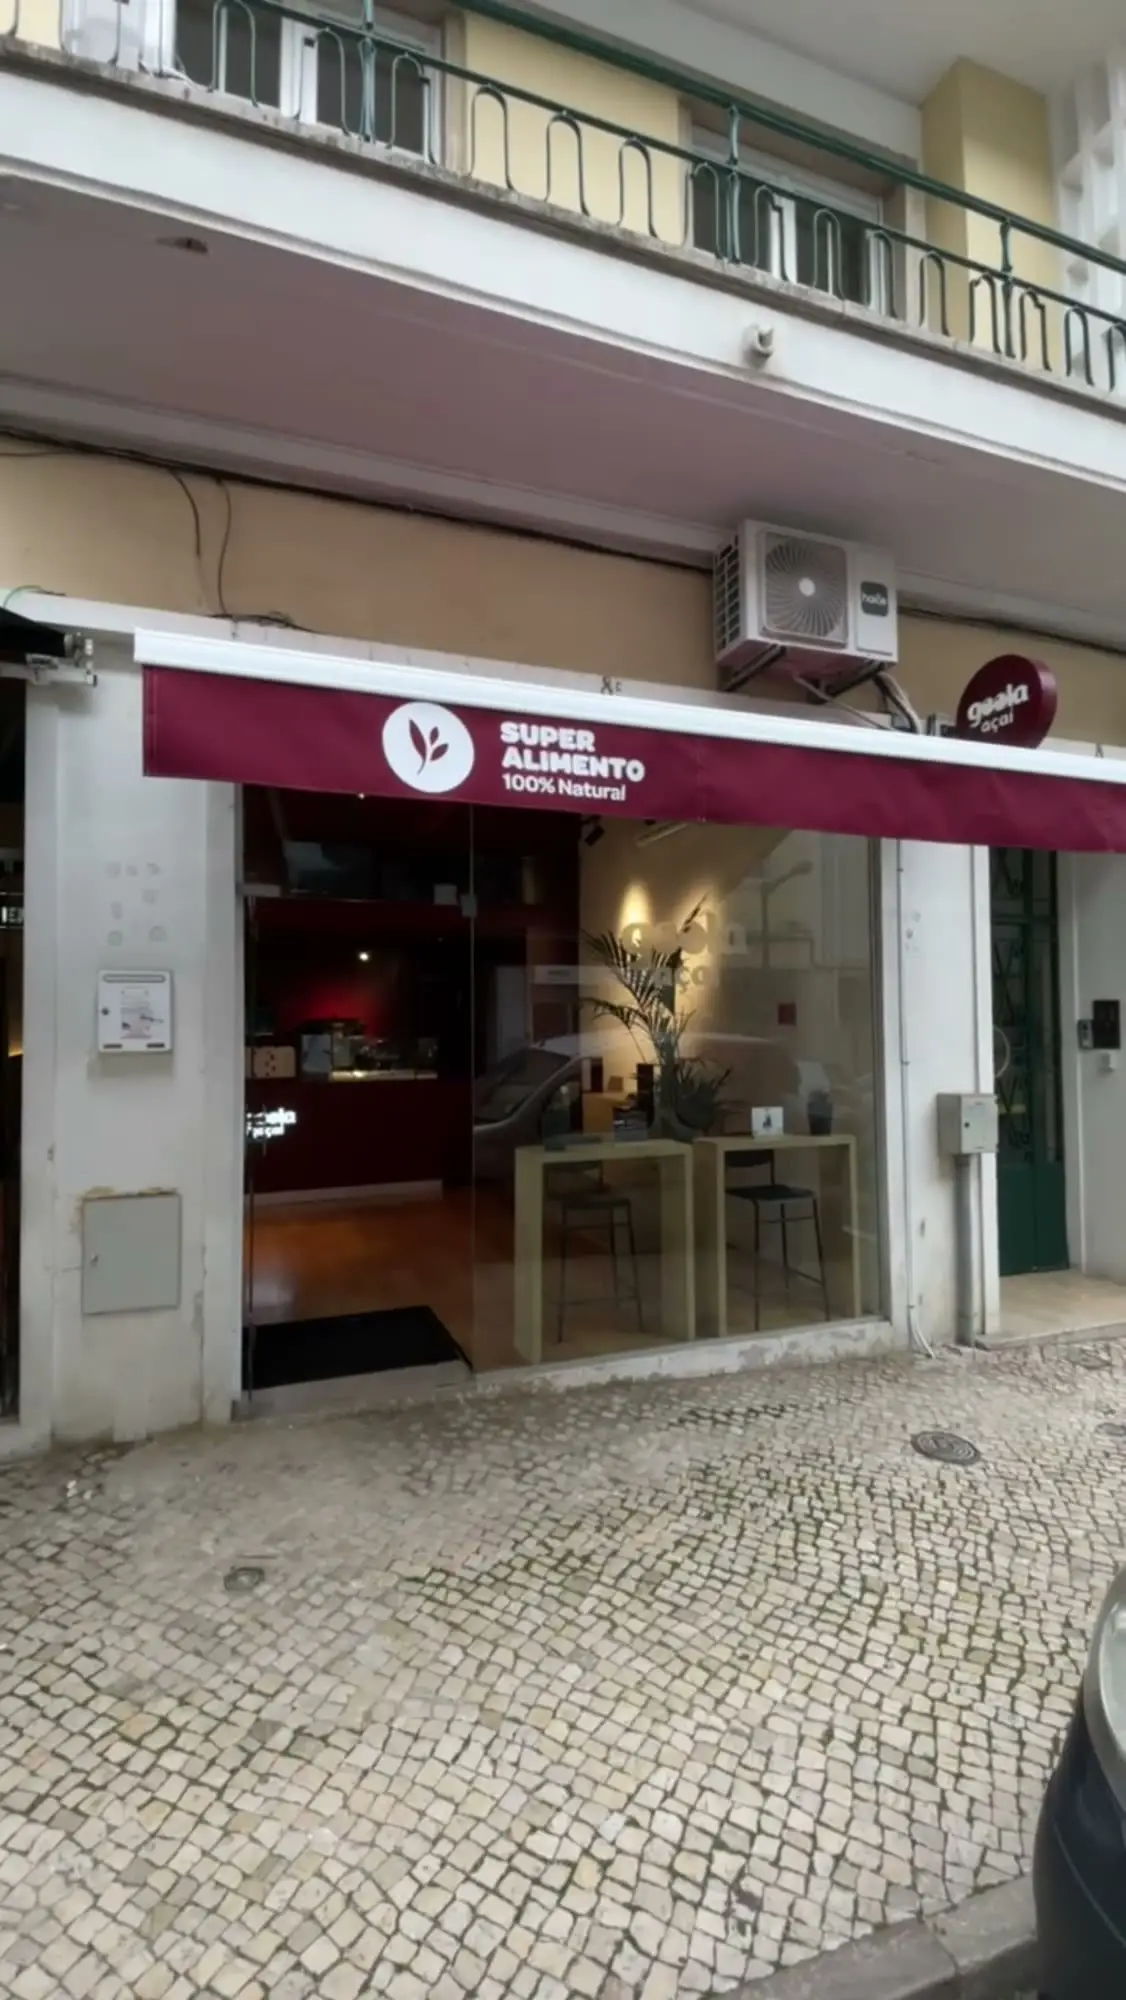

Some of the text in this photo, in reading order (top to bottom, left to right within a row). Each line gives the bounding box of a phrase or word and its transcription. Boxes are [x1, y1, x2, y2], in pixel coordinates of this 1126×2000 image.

[500, 721, 596, 752] SUPER
[501, 746, 646, 783] ALIMENTO
[502, 772, 626, 801] 100% Natural
